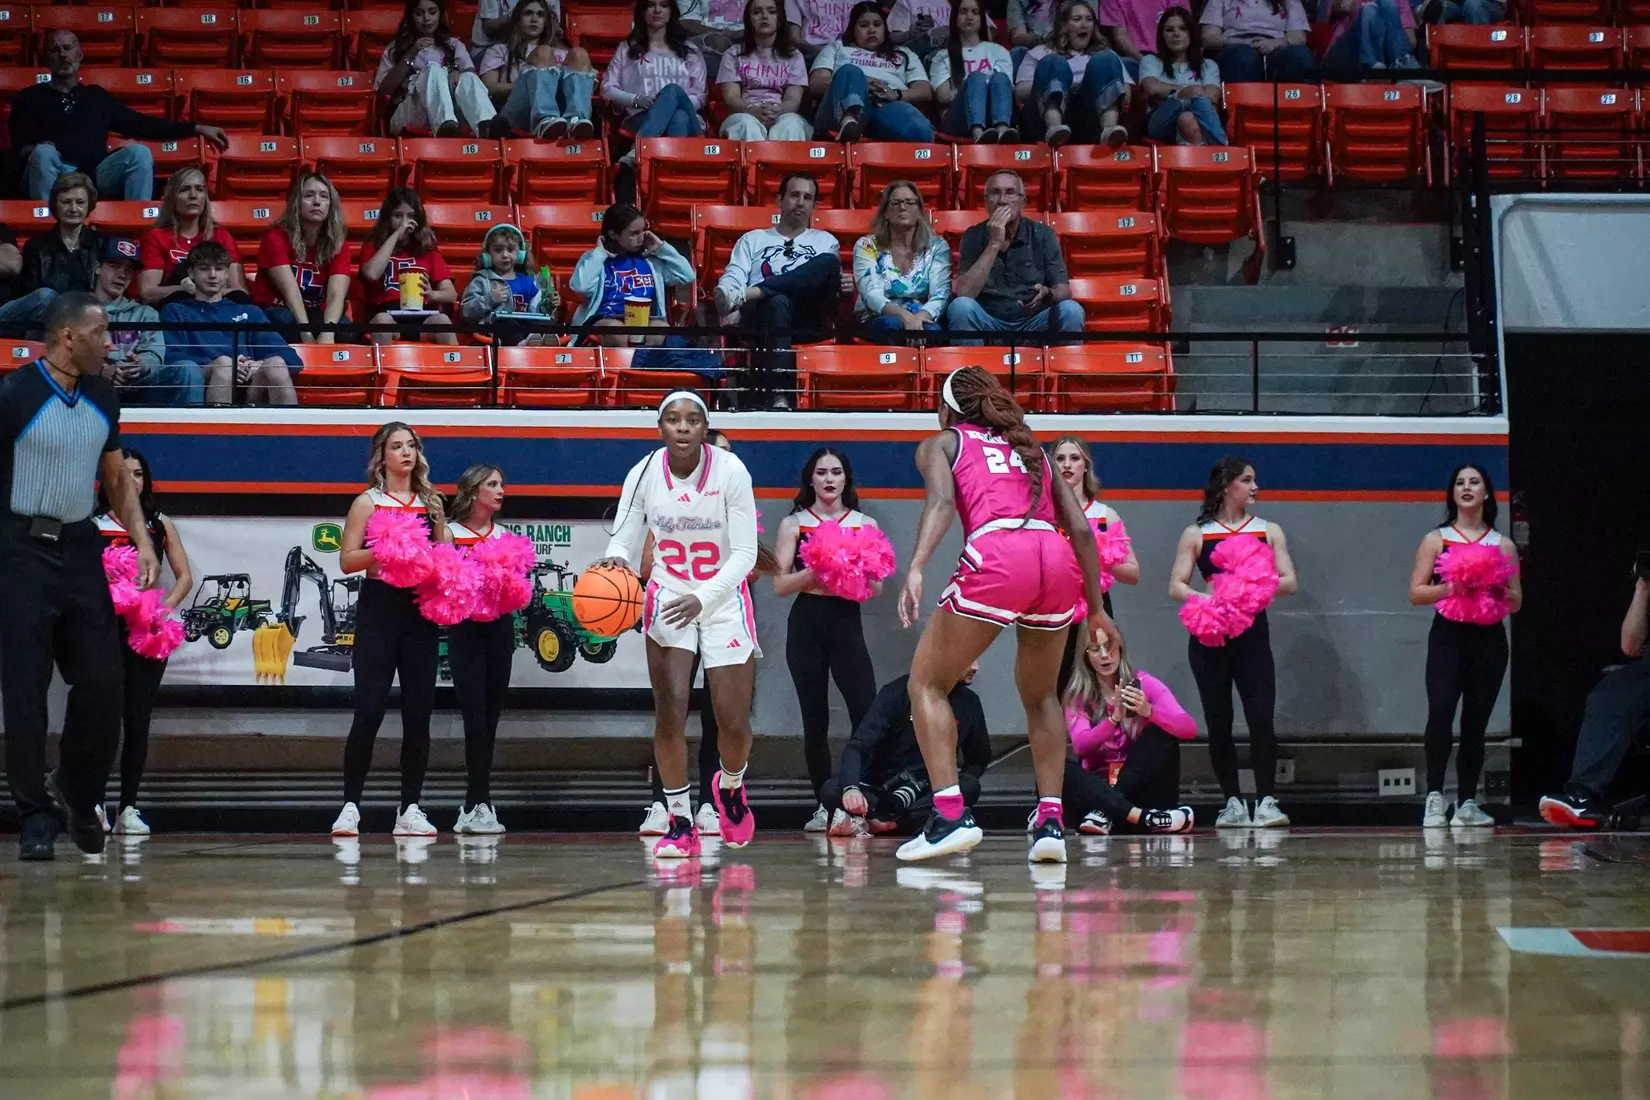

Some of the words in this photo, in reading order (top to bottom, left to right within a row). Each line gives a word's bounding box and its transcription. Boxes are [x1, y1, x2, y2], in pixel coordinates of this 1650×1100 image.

[307, 16, 316, 24] 19
[850, 58, 877, 67] THINK
[140, 75, 148, 83] 15
[240, 76, 249, 84] 16
[340, 77, 349, 85] 17
[1387, 91, 1396, 99] 27
[166, 142, 174, 150] 13
[264, 142, 273, 151] 14
[362, 143, 372, 152] 15
[466, 145, 475, 153] 16
[568, 145, 578, 153] 17
[707, 146, 716, 154] 18
[813, 149, 822, 157] 19
[918, 150, 928, 158] 20
[1018, 151, 1027, 159] 21
[1215, 153, 1226, 161] 23
[256, 209, 266, 218] 10
[479, 212, 488, 220] 12
[1121, 218, 1130, 226] 17
[1123, 286, 1133, 294] 15
[982, 446, 1028, 474] 24
[526, 524, 571, 542] RANCH
[532, 544, 553, 555] URF
[658, 539, 720, 580] 22
